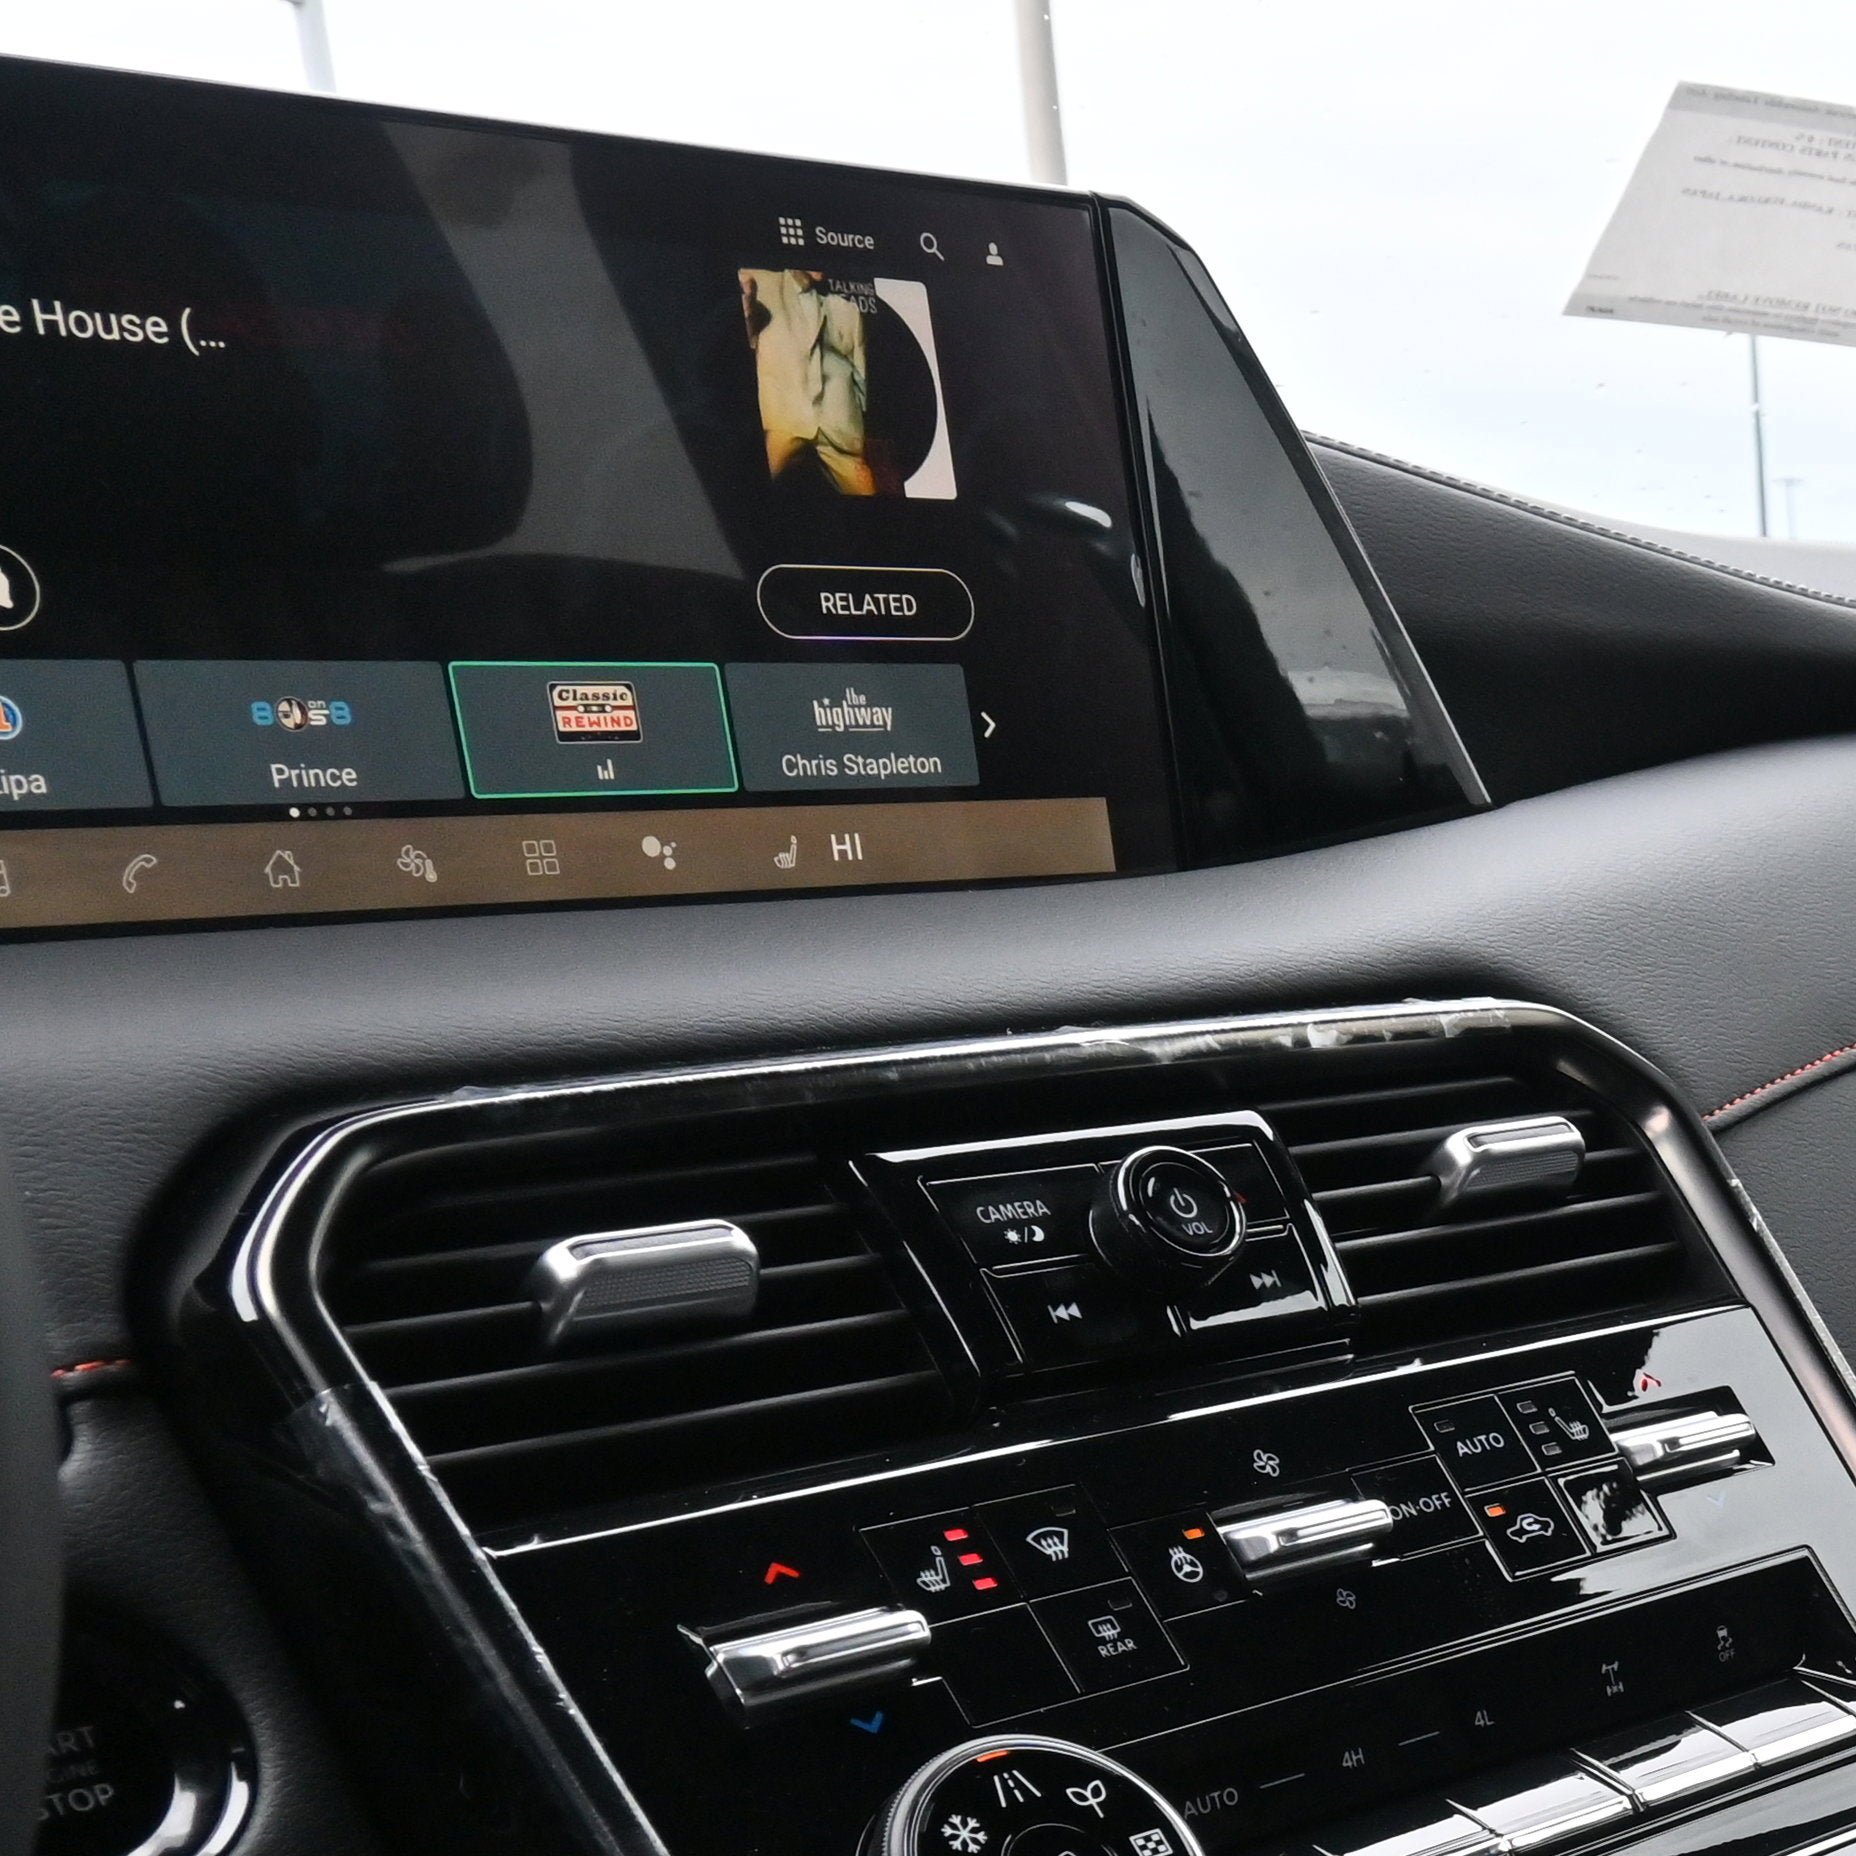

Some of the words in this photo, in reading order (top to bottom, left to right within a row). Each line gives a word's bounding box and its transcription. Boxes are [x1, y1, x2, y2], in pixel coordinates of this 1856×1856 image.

[815, 226, 875, 250] Source
[31, 298, 170, 344] House
[819, 592, 918, 616] RELATED
[557, 687, 629, 703] Classic
[846, 687, 867, 706] the
[560, 714, 635, 730] REWIND
[813, 700, 893, 732] highway
[269, 762, 358, 788] Prince
[782, 754, 838, 777] Chris
[843, 752, 943, 779] Stapleton
[0, 768, 47, 800] ipa
[830, 833, 864, 862] HI
[976, 1199, 1051, 1224] CAMERA
[1181, 1219, 1213, 1236] VOL
[1455, 1431, 1506, 1458] AUTO
[1097, 1638, 1137, 1659] REAR
[1718, 1647, 1737, 1663] OFF
[1474, 1709, 1495, 1728] 4L
[1341, 1747, 1366, 1769] 4H
[1183, 1787, 1239, 1820] AUTO
